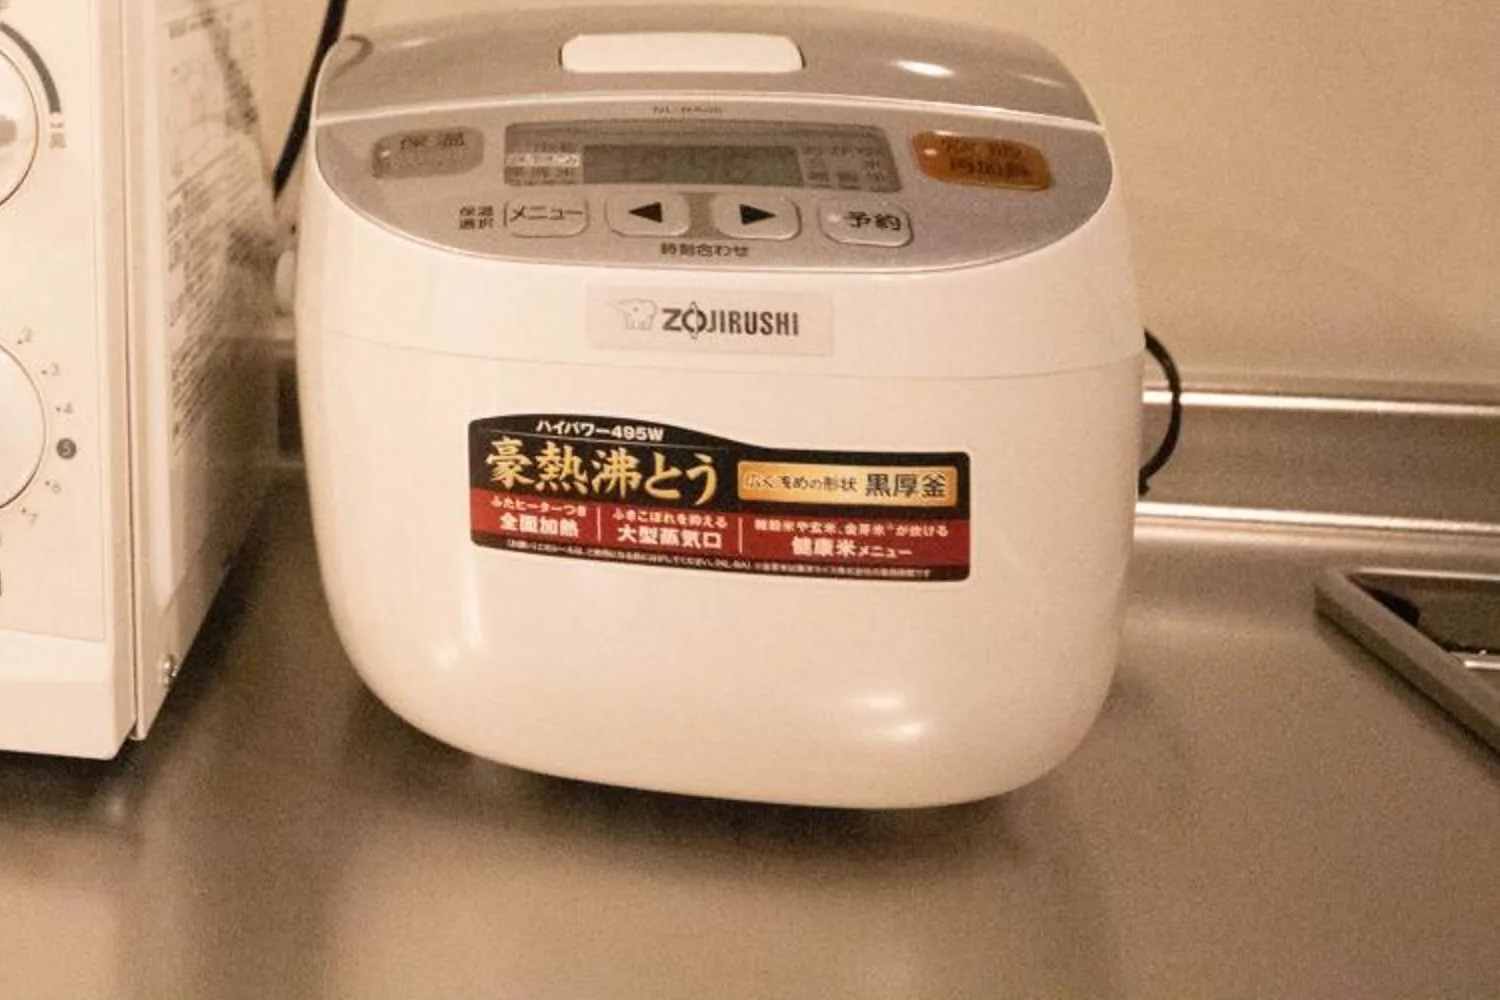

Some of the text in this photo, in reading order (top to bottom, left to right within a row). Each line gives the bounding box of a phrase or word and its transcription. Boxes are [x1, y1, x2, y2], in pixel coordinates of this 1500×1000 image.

[509, 201, 584, 222] メニュー
[847, 210, 901, 232] 予約
[661, 301, 799, 340] ZOJIRUSHI
[536, 419, 665, 442] ハイパワー495W
[485, 436, 719, 506] 豪熱沸とう
[864, 473, 947, 498] 黒厚釜
[500, 512, 579, 539] 全面加熱
[617, 524, 722, 549] 大型蒸気口
